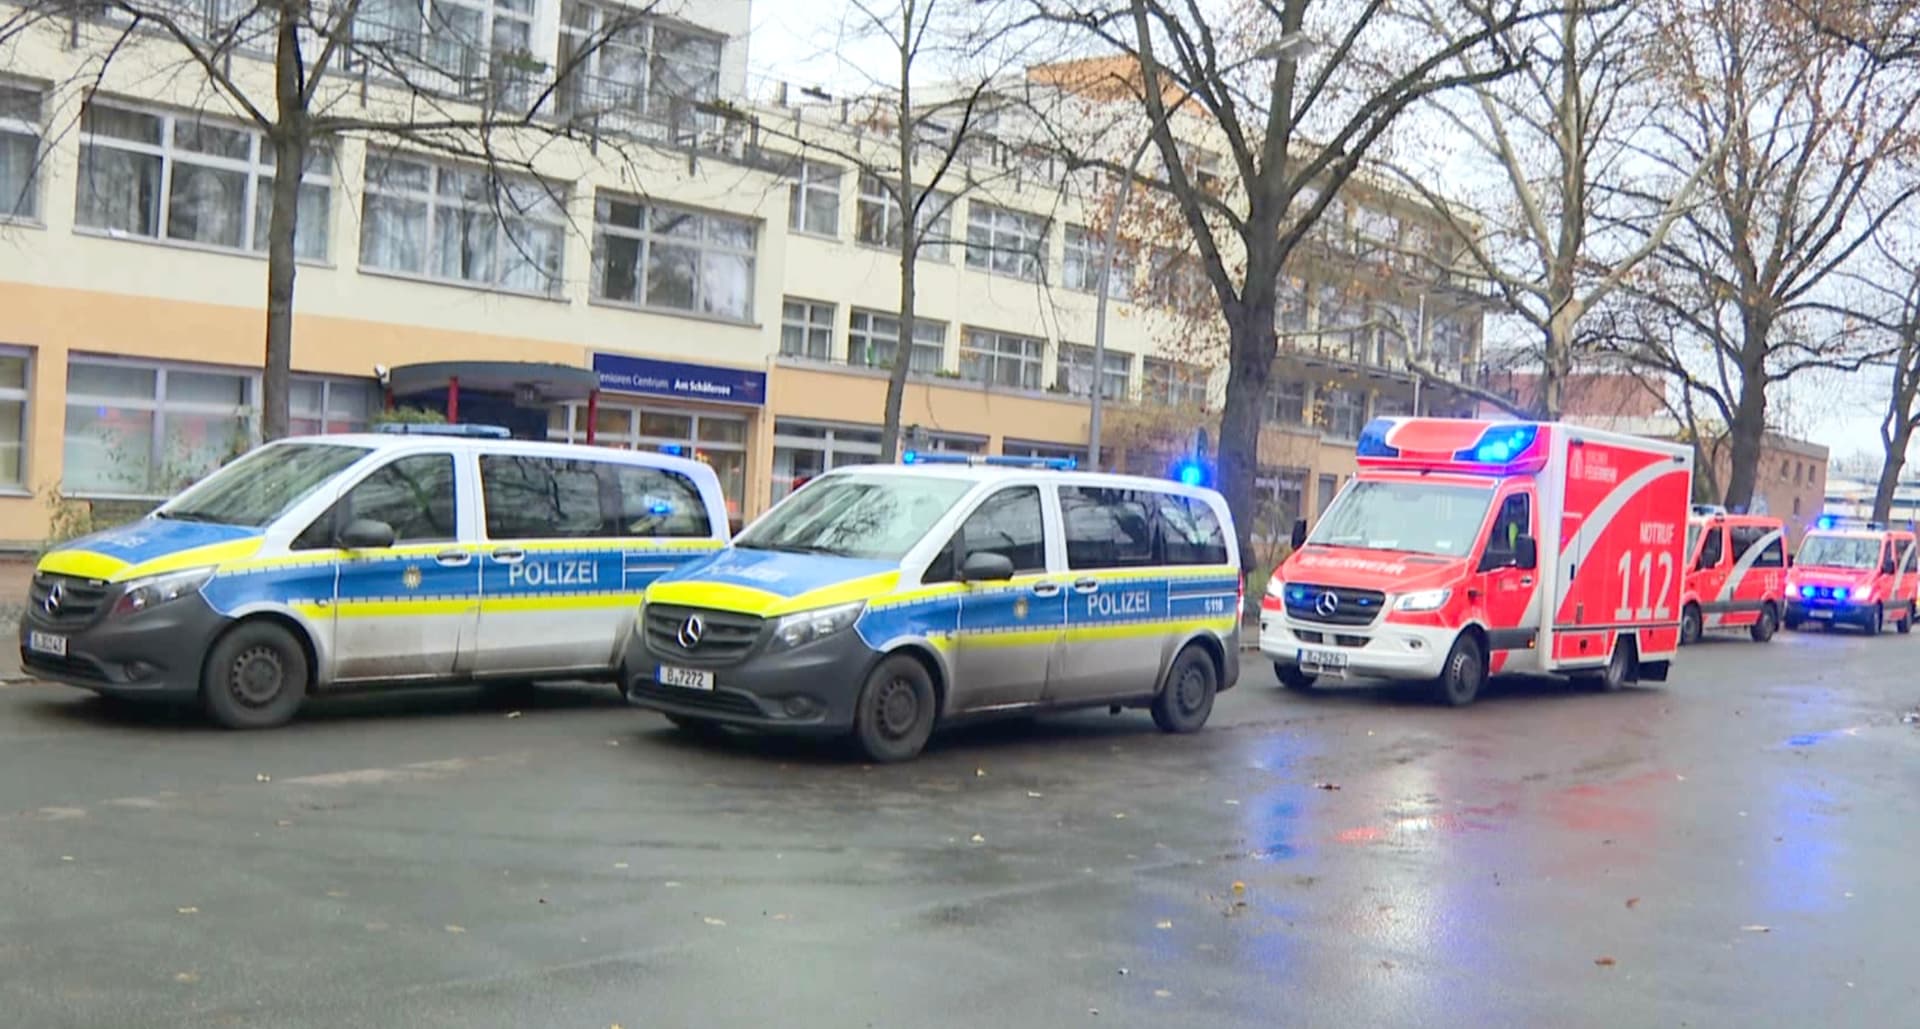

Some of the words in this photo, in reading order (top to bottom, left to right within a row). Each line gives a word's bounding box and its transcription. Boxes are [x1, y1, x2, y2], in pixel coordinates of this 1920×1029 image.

[600, 373, 632, 385] enioren
[633, 374, 669, 389] Centrum
[674, 378, 689, 391] Am
[690, 379, 732, 397] Schäfersee
[1640, 522, 1675, 545] NOTRUF
[508, 559, 599, 587] POLIZEI
[1614, 550, 1674, 620] 112
[1087, 591, 1150, 617] POLIZEI
